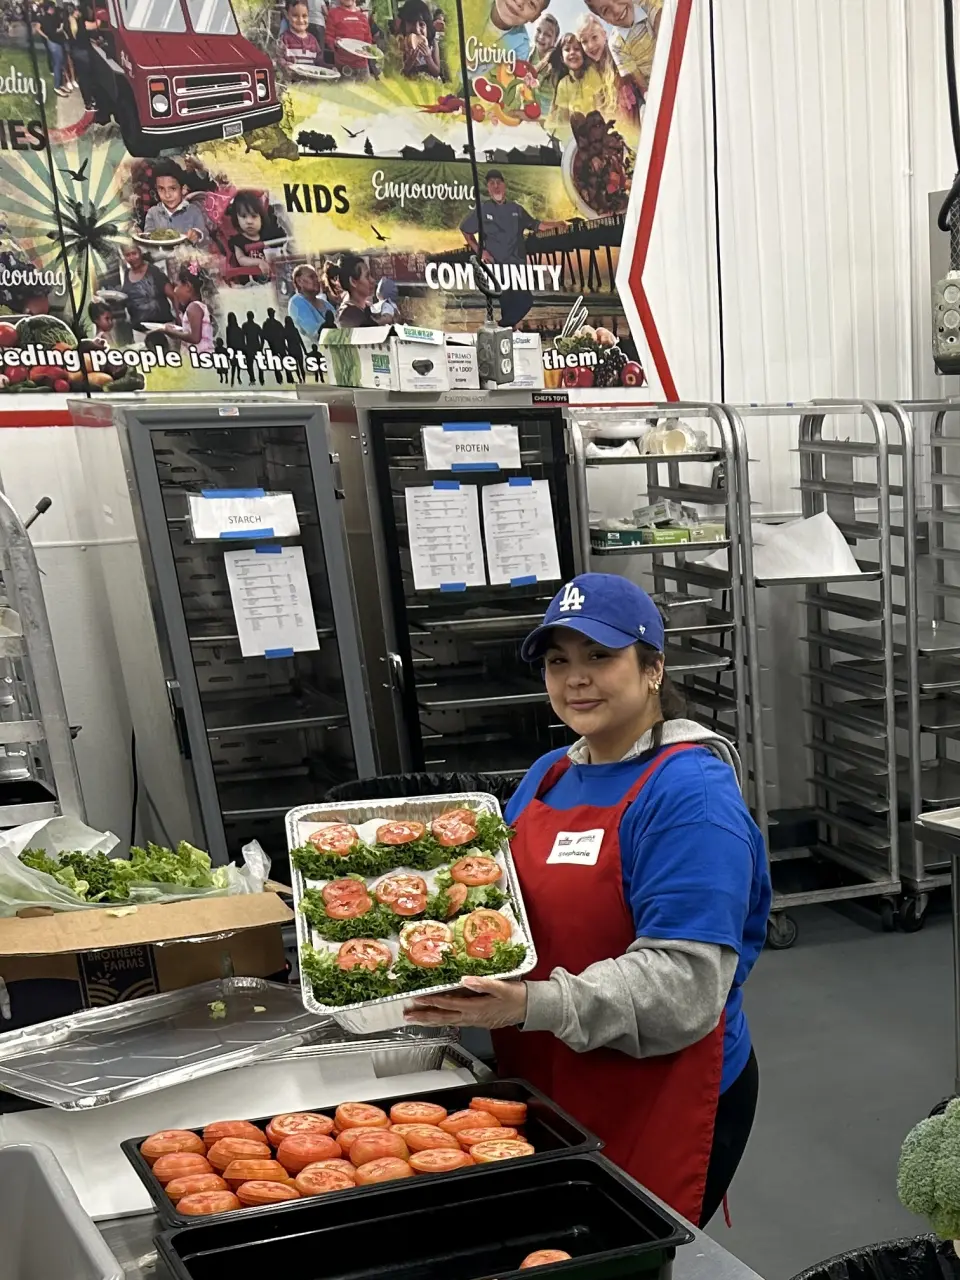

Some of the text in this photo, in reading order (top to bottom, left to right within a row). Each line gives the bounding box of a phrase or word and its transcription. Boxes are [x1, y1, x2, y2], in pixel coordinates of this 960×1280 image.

[465, 36, 517, 75] Giving
[284, 183, 349, 214] KIDS
[0, 344, 81, 372] eding
[90, 345, 181, 373] people
[190, 345, 248, 370] isn't
[255, 348, 297, 371] the
[542, 349, 605, 370] them.
[454, 443, 490, 454] PROTEIN
[228, 514, 262, 525] STARCH
[559, 582, 585, 612] LA
[103, 957, 145, 971] FARMS
